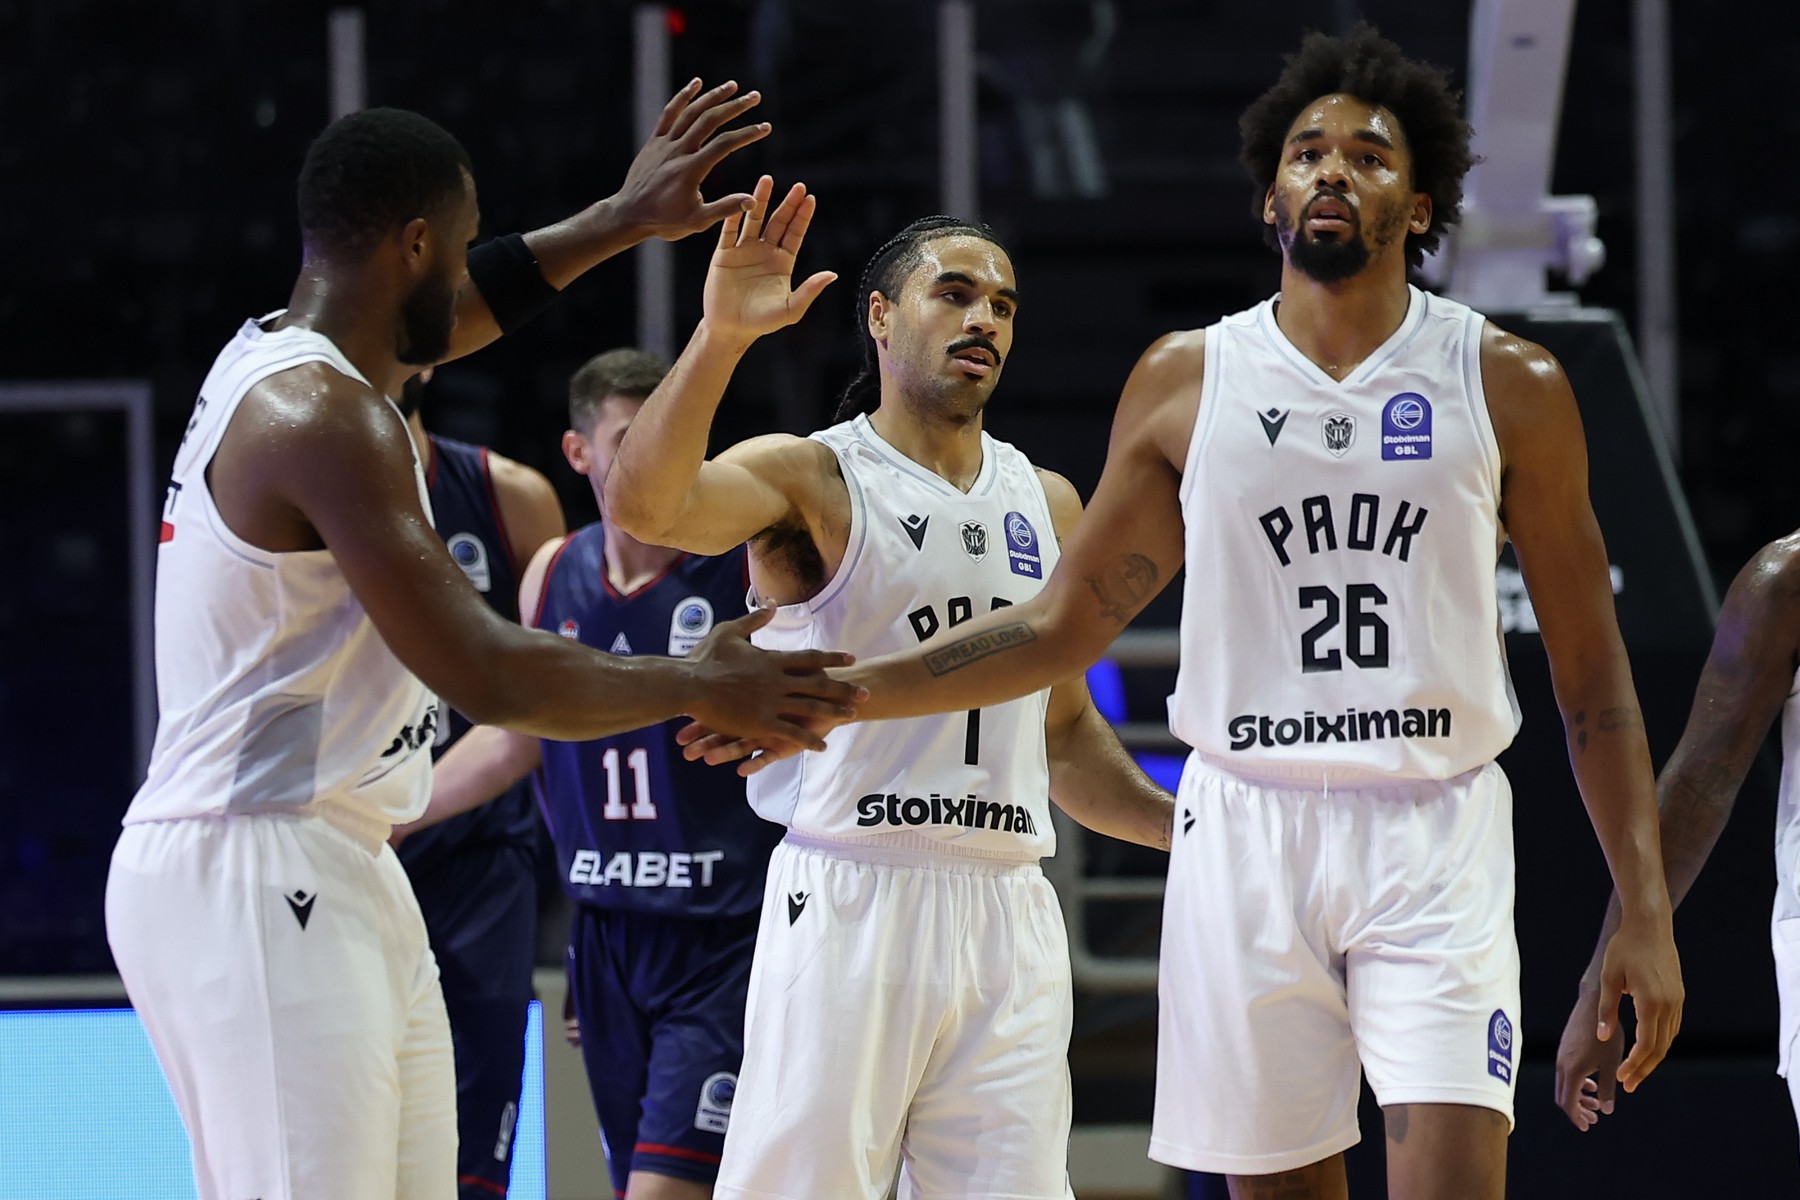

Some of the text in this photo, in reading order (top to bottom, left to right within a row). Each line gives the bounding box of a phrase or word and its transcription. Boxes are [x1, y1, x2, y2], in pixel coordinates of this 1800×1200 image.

[1384, 434, 1431, 444] Stoiximan
[1394, 445, 1419, 456] GBL
[1258, 493, 1429, 567] PAOK
[1018, 562, 1034, 573] GBL
[907, 596, 1013, 643] PA
[1299, 583, 1389, 674] 26
[930, 626, 1029, 670] SPREAD LOVE
[1228, 708, 1451, 751] Stoiximan
[602, 748, 657, 820] 11
[856, 793, 1038, 836] Stoiximan
[569, 849, 724, 888] ELABET
